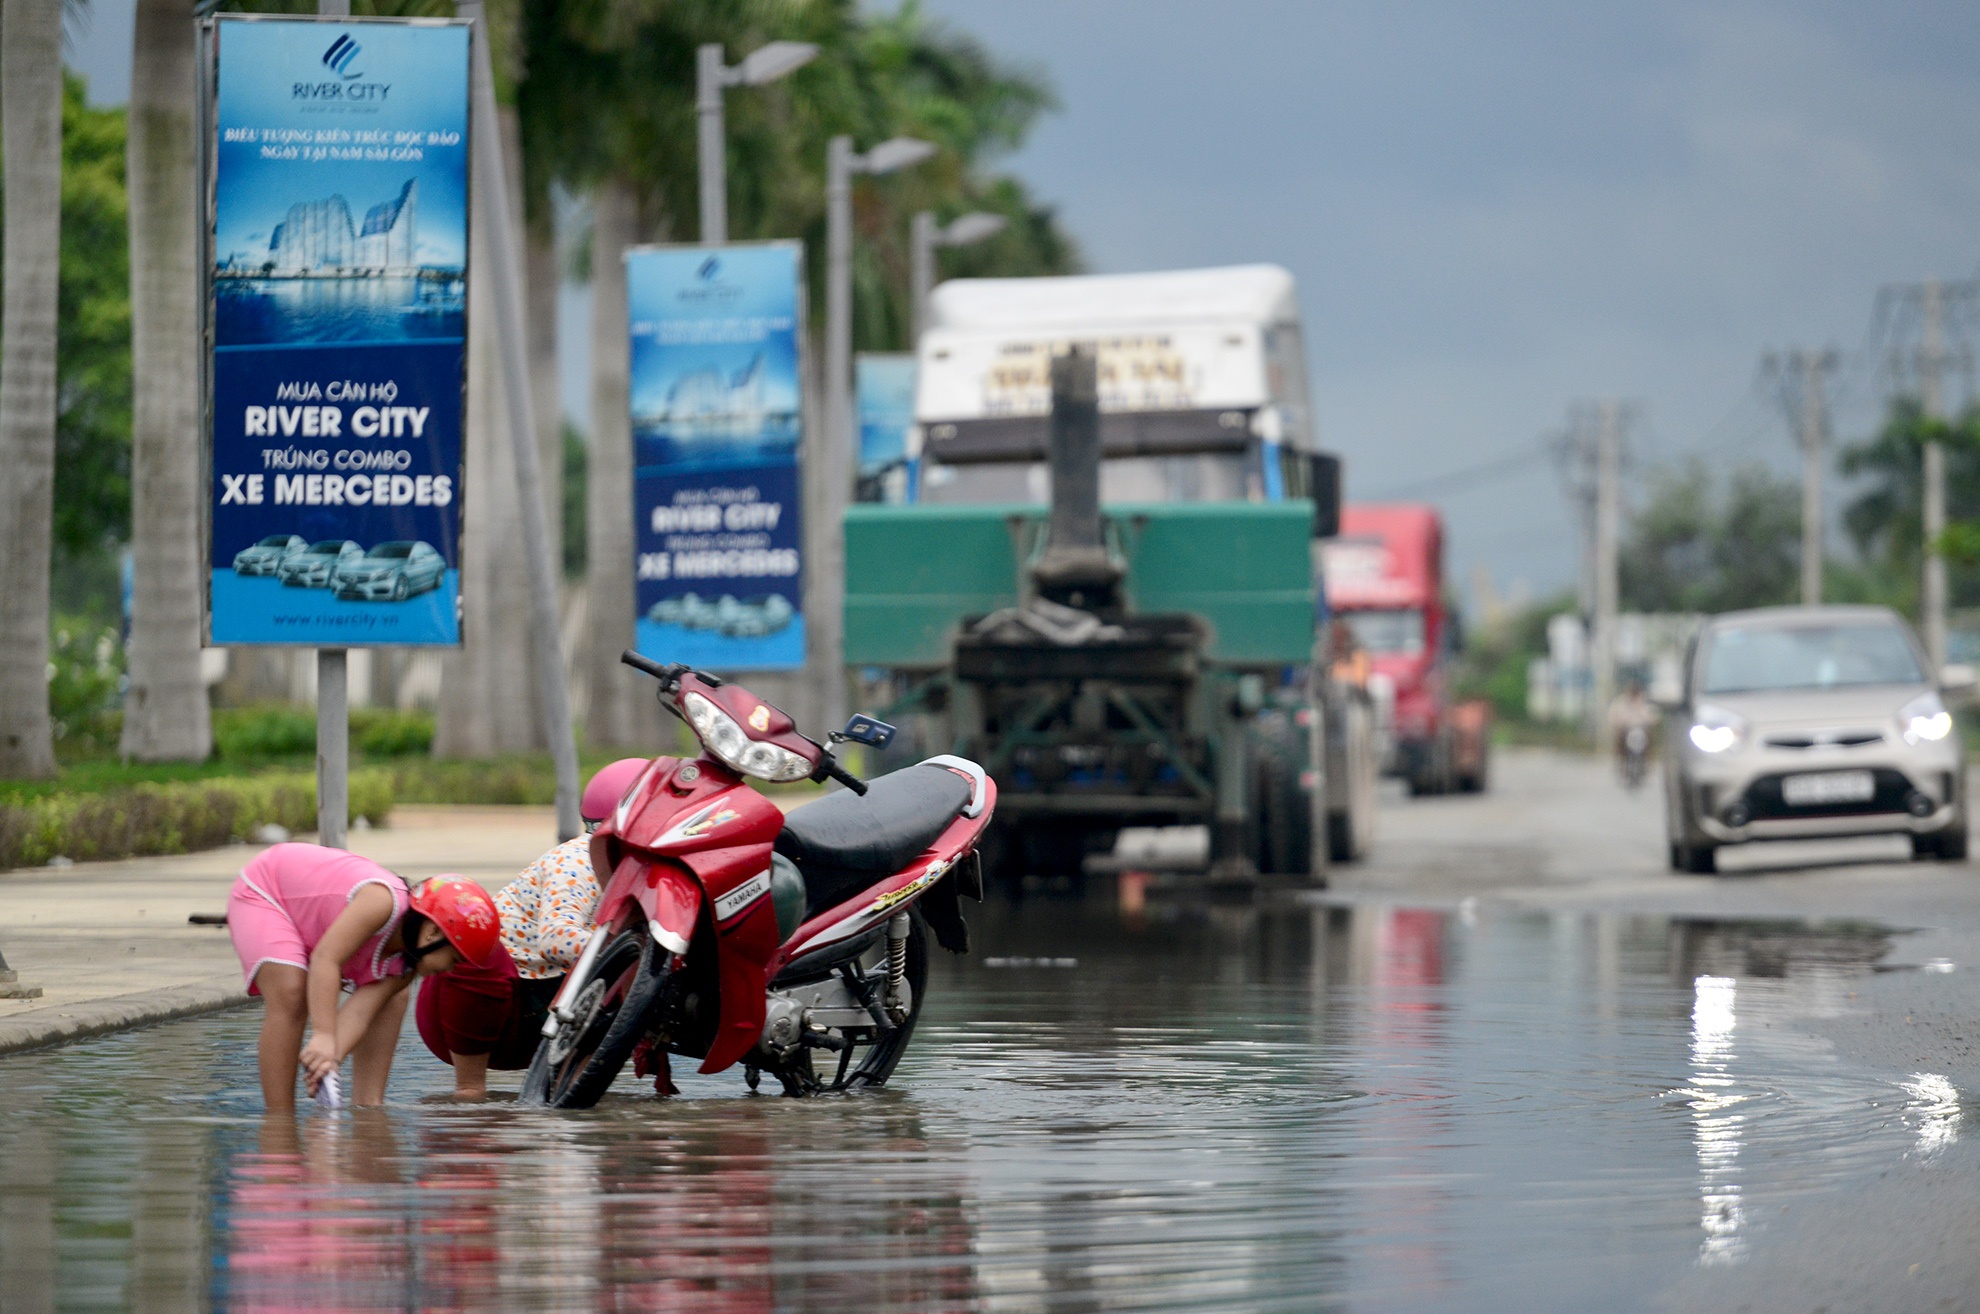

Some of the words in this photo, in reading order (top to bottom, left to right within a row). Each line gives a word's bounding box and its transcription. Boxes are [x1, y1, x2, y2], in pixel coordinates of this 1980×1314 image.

[292, 82, 343, 99] RIVER
[347, 82, 391, 100] CITY
[276, 382, 322, 401] MUA
[325, 380, 367, 401] CĂN
[369, 380, 398, 405] HỘ
[245, 406, 342, 437] RIVER
[351, 406, 430, 438] CITY
[261, 445, 329, 470] TRÚNG
[333, 449, 412, 471] COMBO
[220, 474, 264, 505] XE
[274, 474, 452, 506] MERCEDES
[727, 883, 762, 909] YAMAHA
